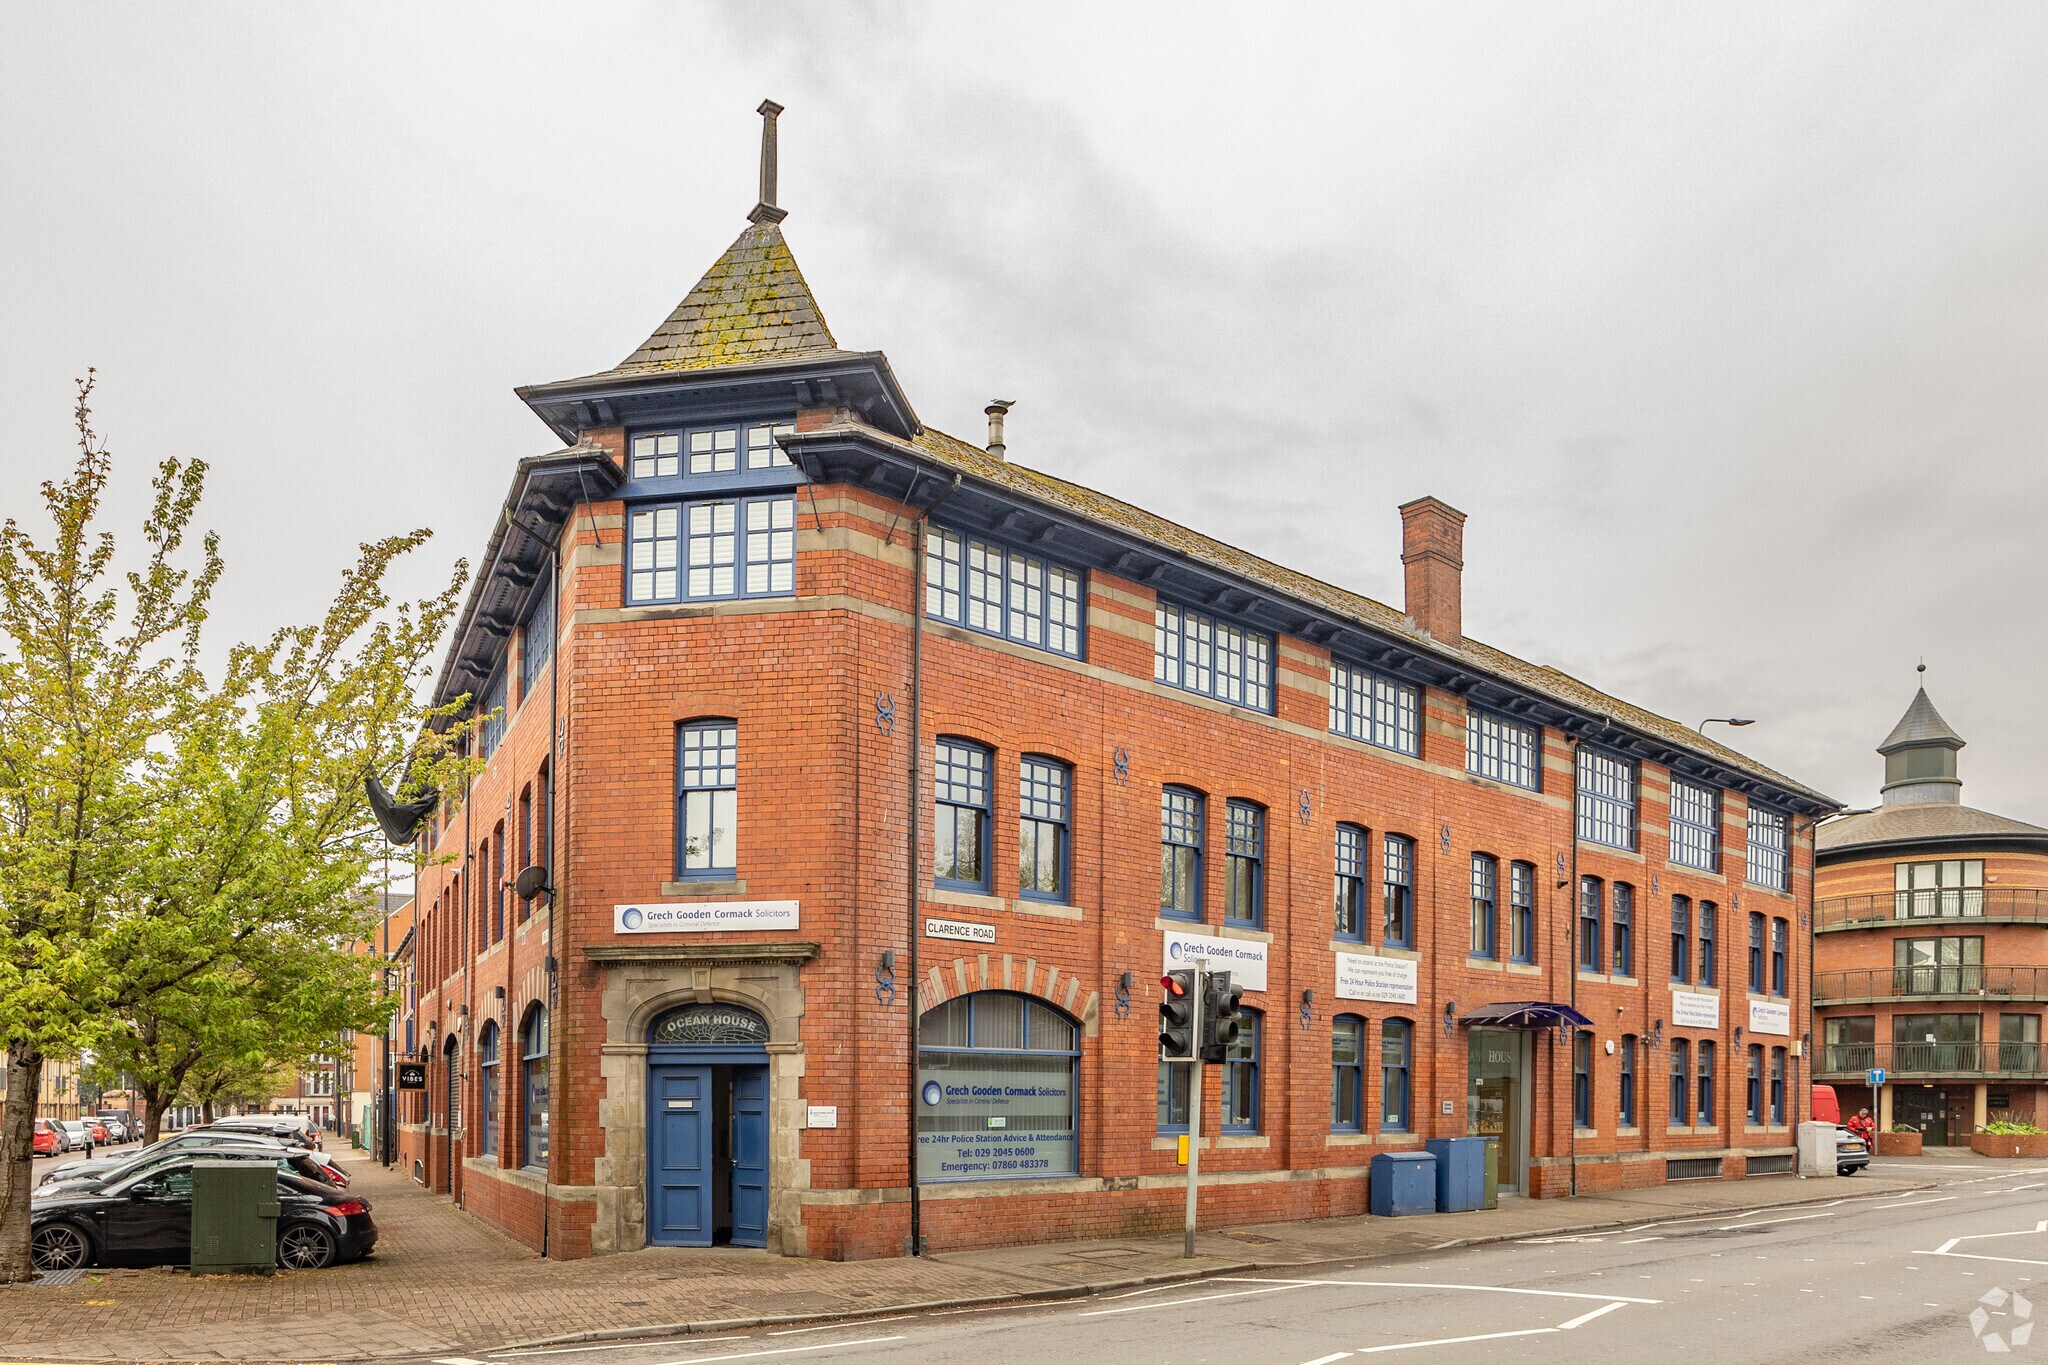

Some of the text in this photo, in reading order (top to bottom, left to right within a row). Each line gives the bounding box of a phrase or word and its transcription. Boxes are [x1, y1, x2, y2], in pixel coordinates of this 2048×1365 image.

[647, 909, 790, 920] Grech Gooden Cormack Solicitors
[928, 923, 994, 938] CLARENCE ROAD
[1184, 943, 1264, 961] Grech Gooden Cormack
[667, 1015, 757, 1032] OCEAN HOUSE
[945, 1085, 1066, 1097] Grech Gooden Cormack Solicitors
[974, 1097, 992, 1105] Criminal
[992, 1097, 1010, 1105] Defence
[918, 1133, 1073, 1144] ree 24hr Police Station Advice & Attendance
[957, 1147, 1035, 1158] Tel: 029 2045 0600
[941, 1159, 1049, 1173] Emergency: 07860 483378
